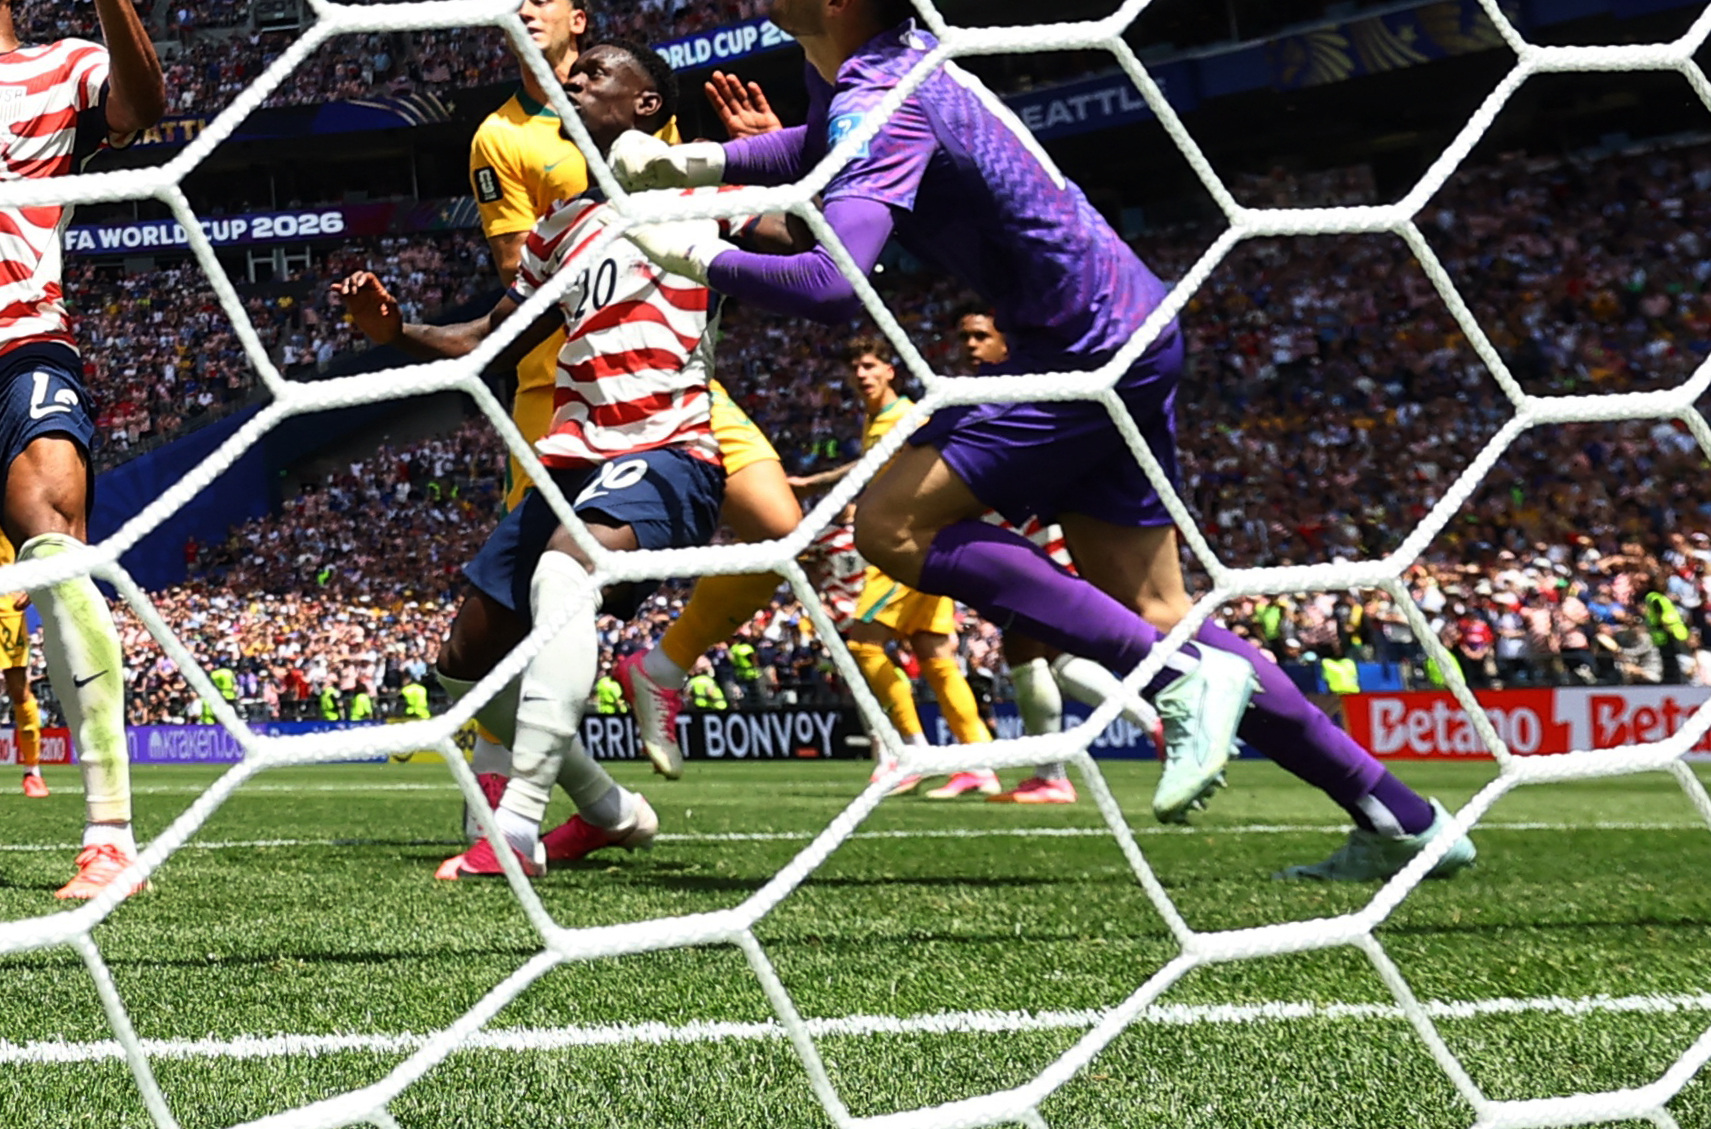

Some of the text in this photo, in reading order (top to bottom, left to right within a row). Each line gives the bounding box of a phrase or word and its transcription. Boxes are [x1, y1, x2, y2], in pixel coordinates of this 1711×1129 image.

[713, 25, 759, 58] CUP
[98, 223, 188, 249] WORLD
[251, 211, 344, 239] 2026
[573, 458, 648, 509] 20
[1, 626, 25, 652] 24
[702, 712, 837, 758] BONVOY
